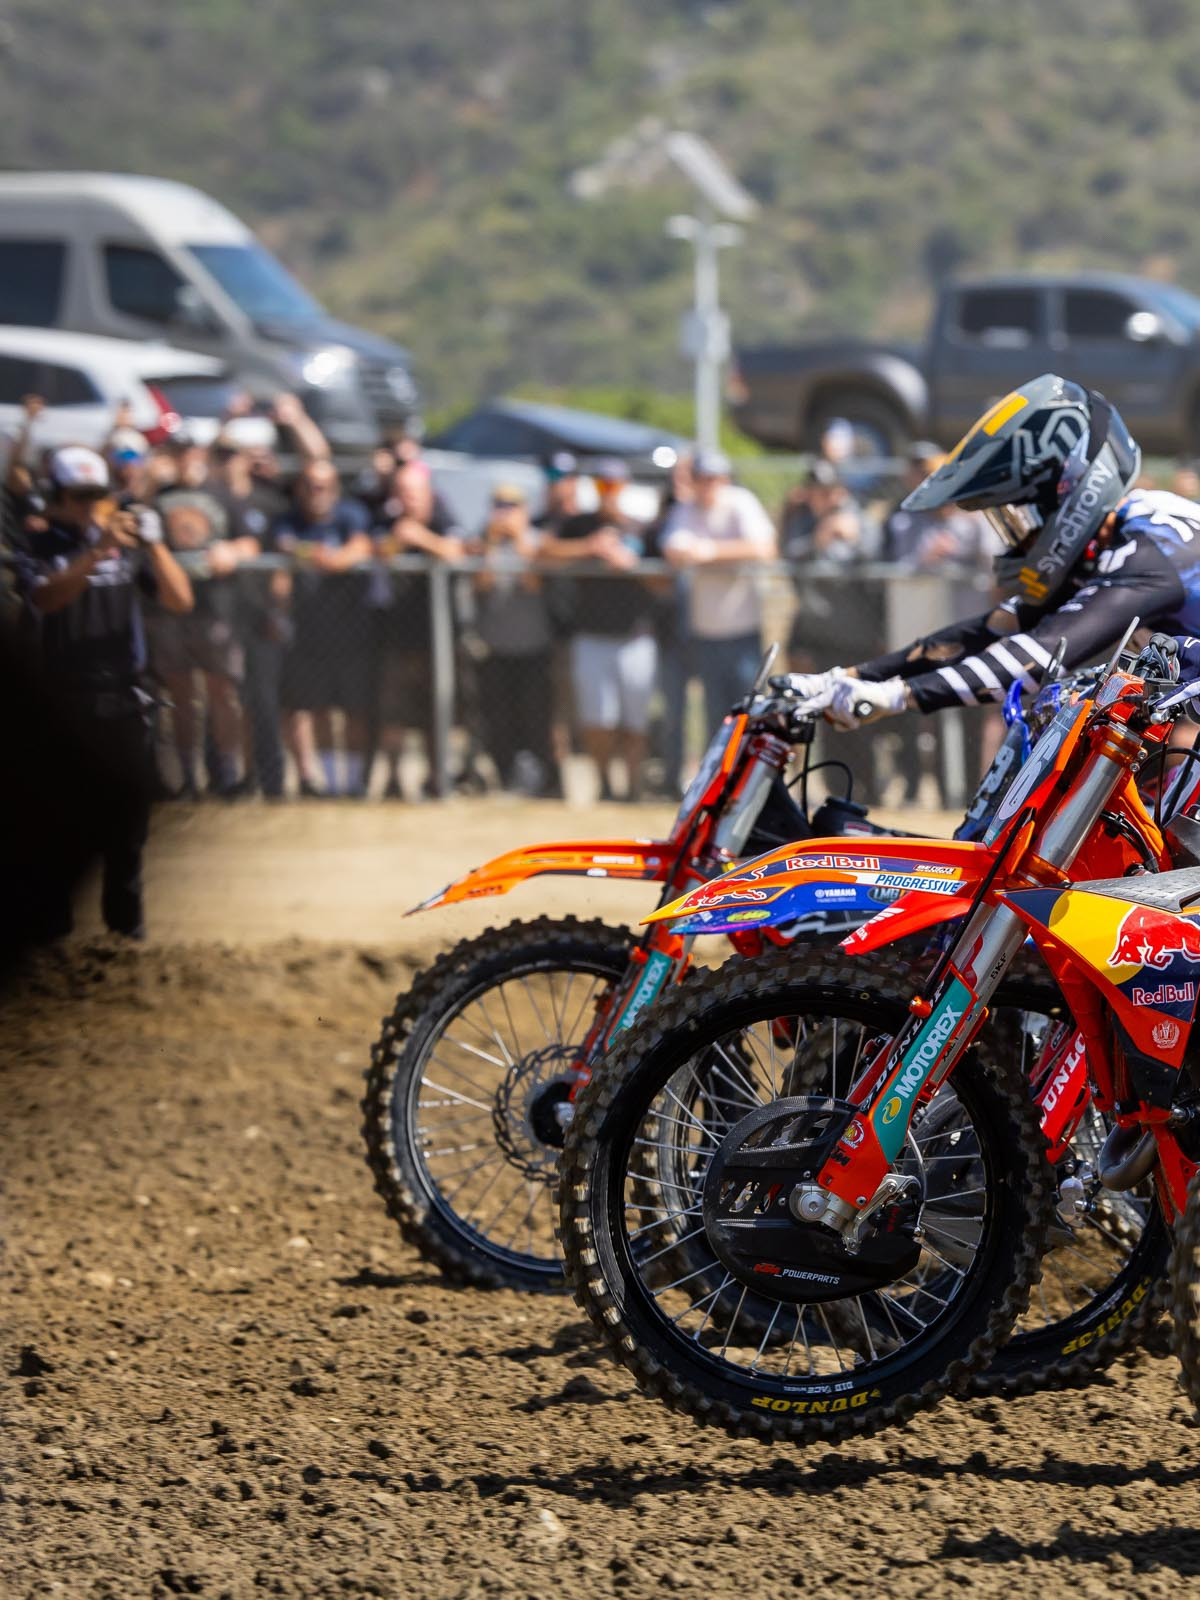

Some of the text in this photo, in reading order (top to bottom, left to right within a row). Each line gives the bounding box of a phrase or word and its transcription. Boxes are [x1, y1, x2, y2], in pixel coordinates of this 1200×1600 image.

[1037, 461, 1112, 574] synchrony
[786, 856, 880, 870] Red Bull
[824, 888, 856, 897] YAMAHA
[875, 874, 963, 893] PROGRESSIVE
[1132, 982, 1195, 1006] Red Bull
[894, 1004, 963, 1099] MOTOREX
[751, 1391, 869, 1414] DUNLOP
